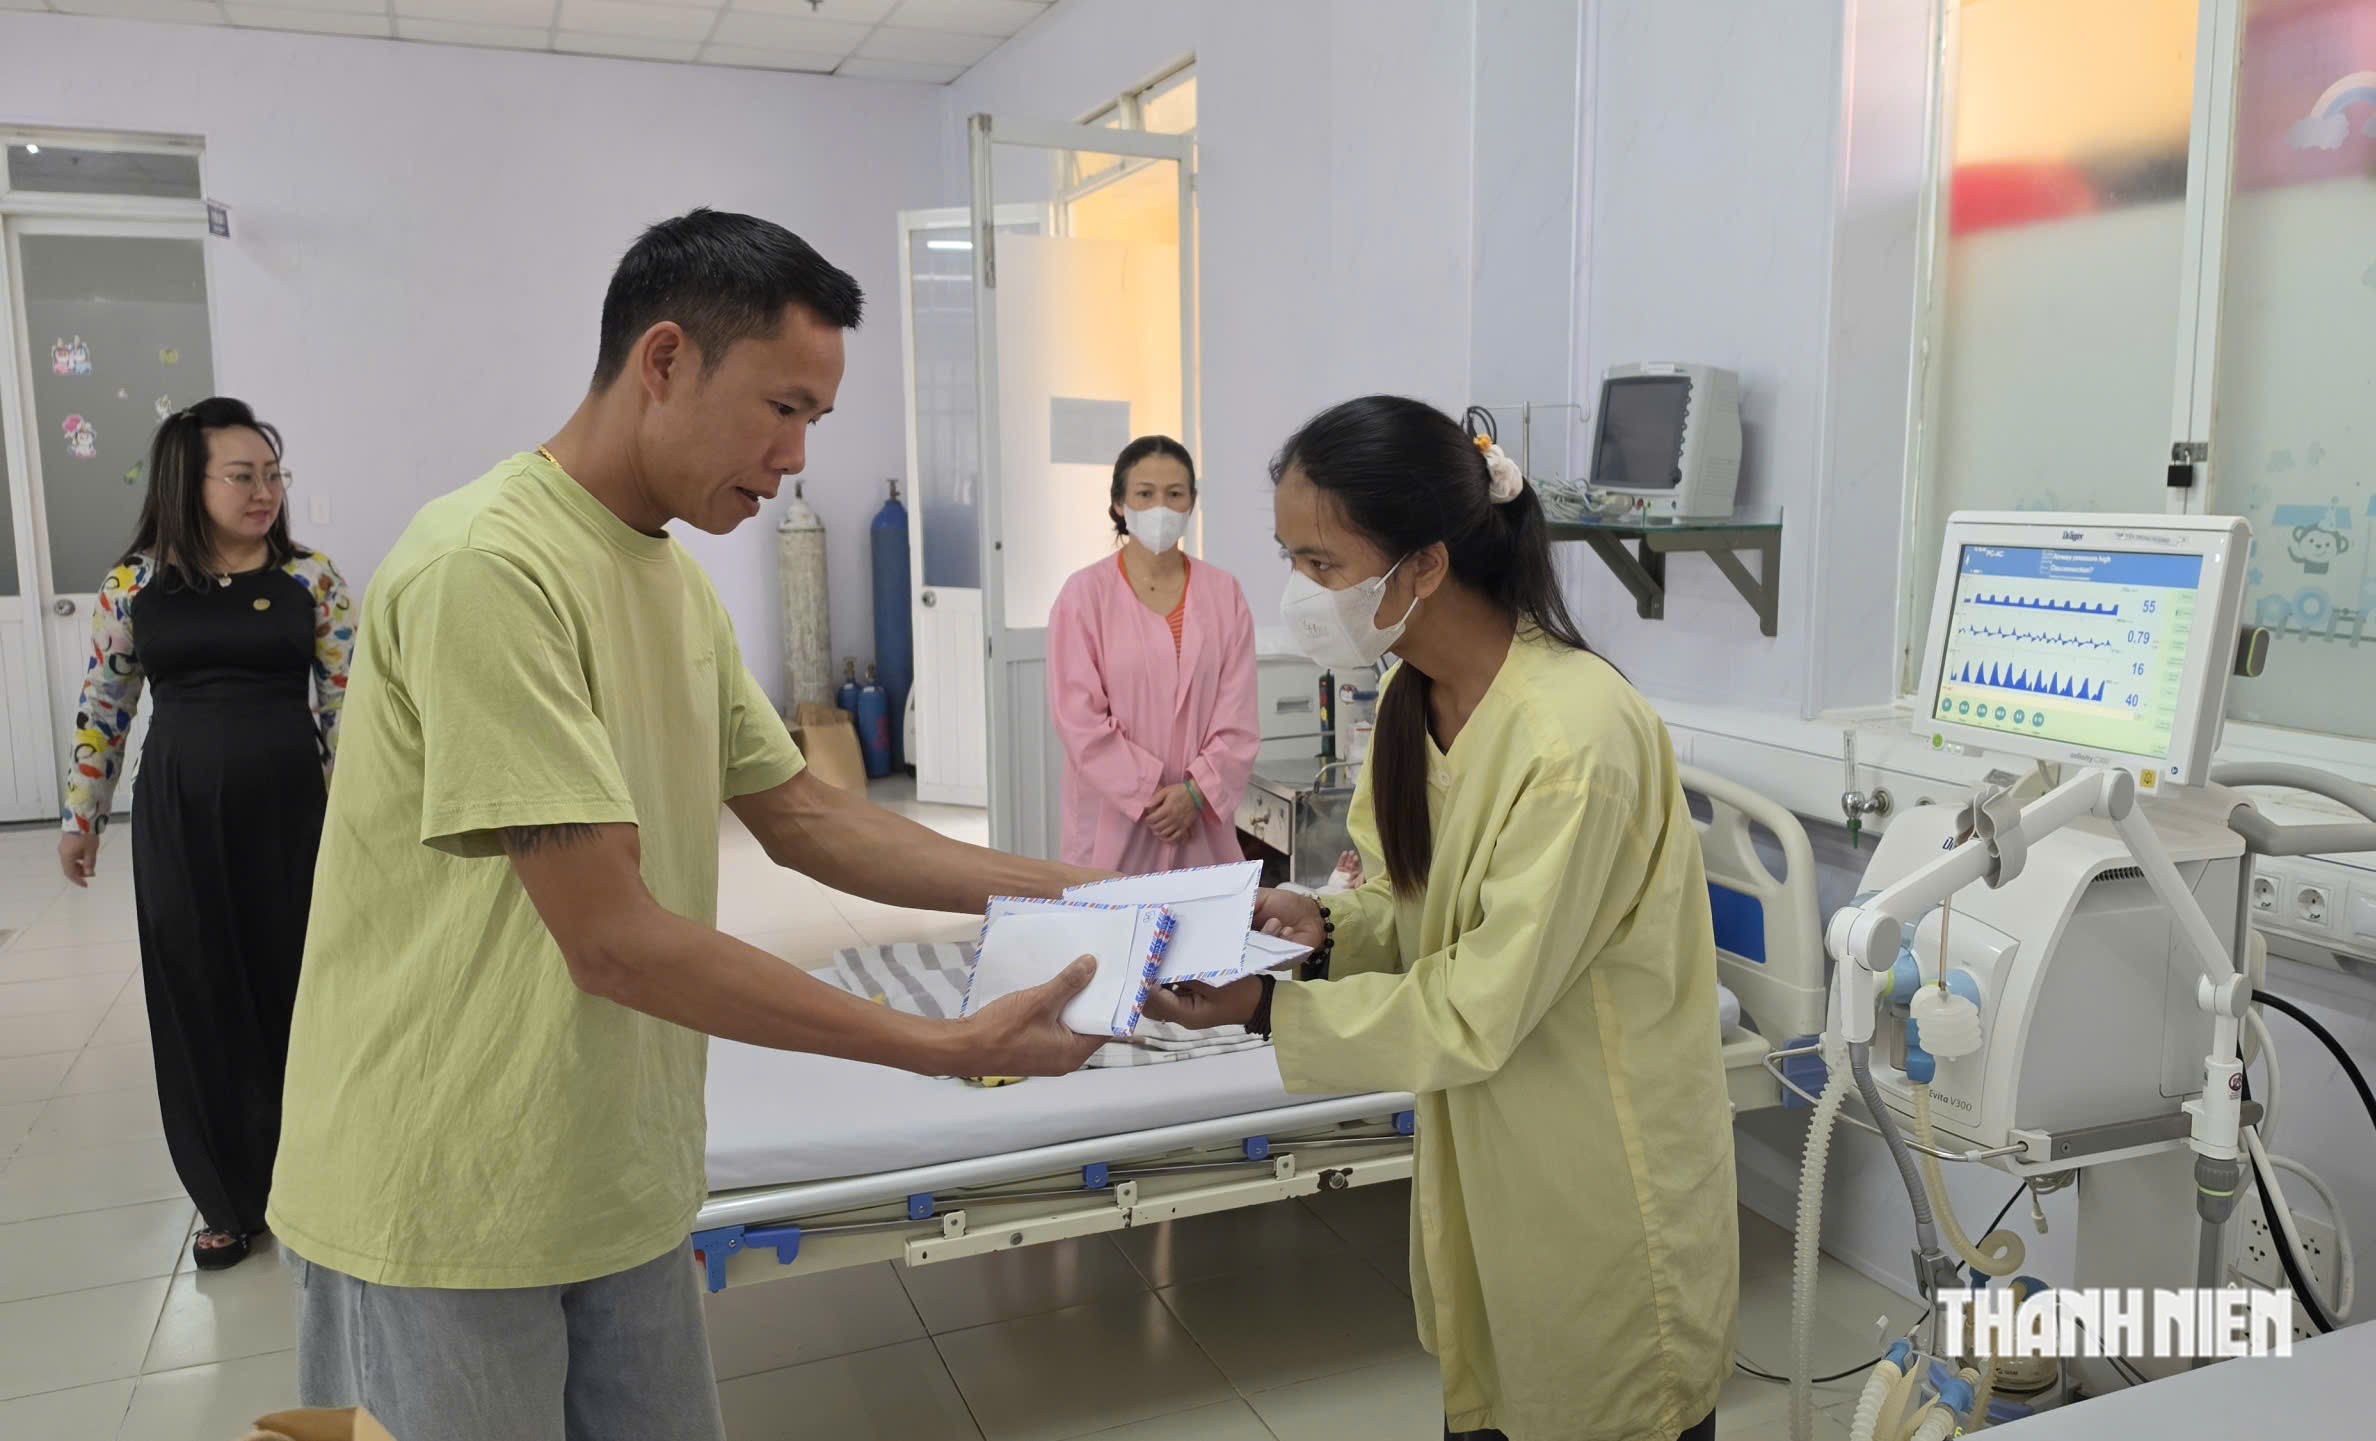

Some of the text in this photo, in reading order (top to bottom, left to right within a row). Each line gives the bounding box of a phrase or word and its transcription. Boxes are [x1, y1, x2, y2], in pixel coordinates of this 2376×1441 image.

[2142, 600, 2156, 613] 55
[2127, 630, 2150, 645] 0.79
[2132, 663, 2145, 676] 16
[2125, 694, 2139, 707] 40
[1928, 1089, 1973, 1112] Evita V300
